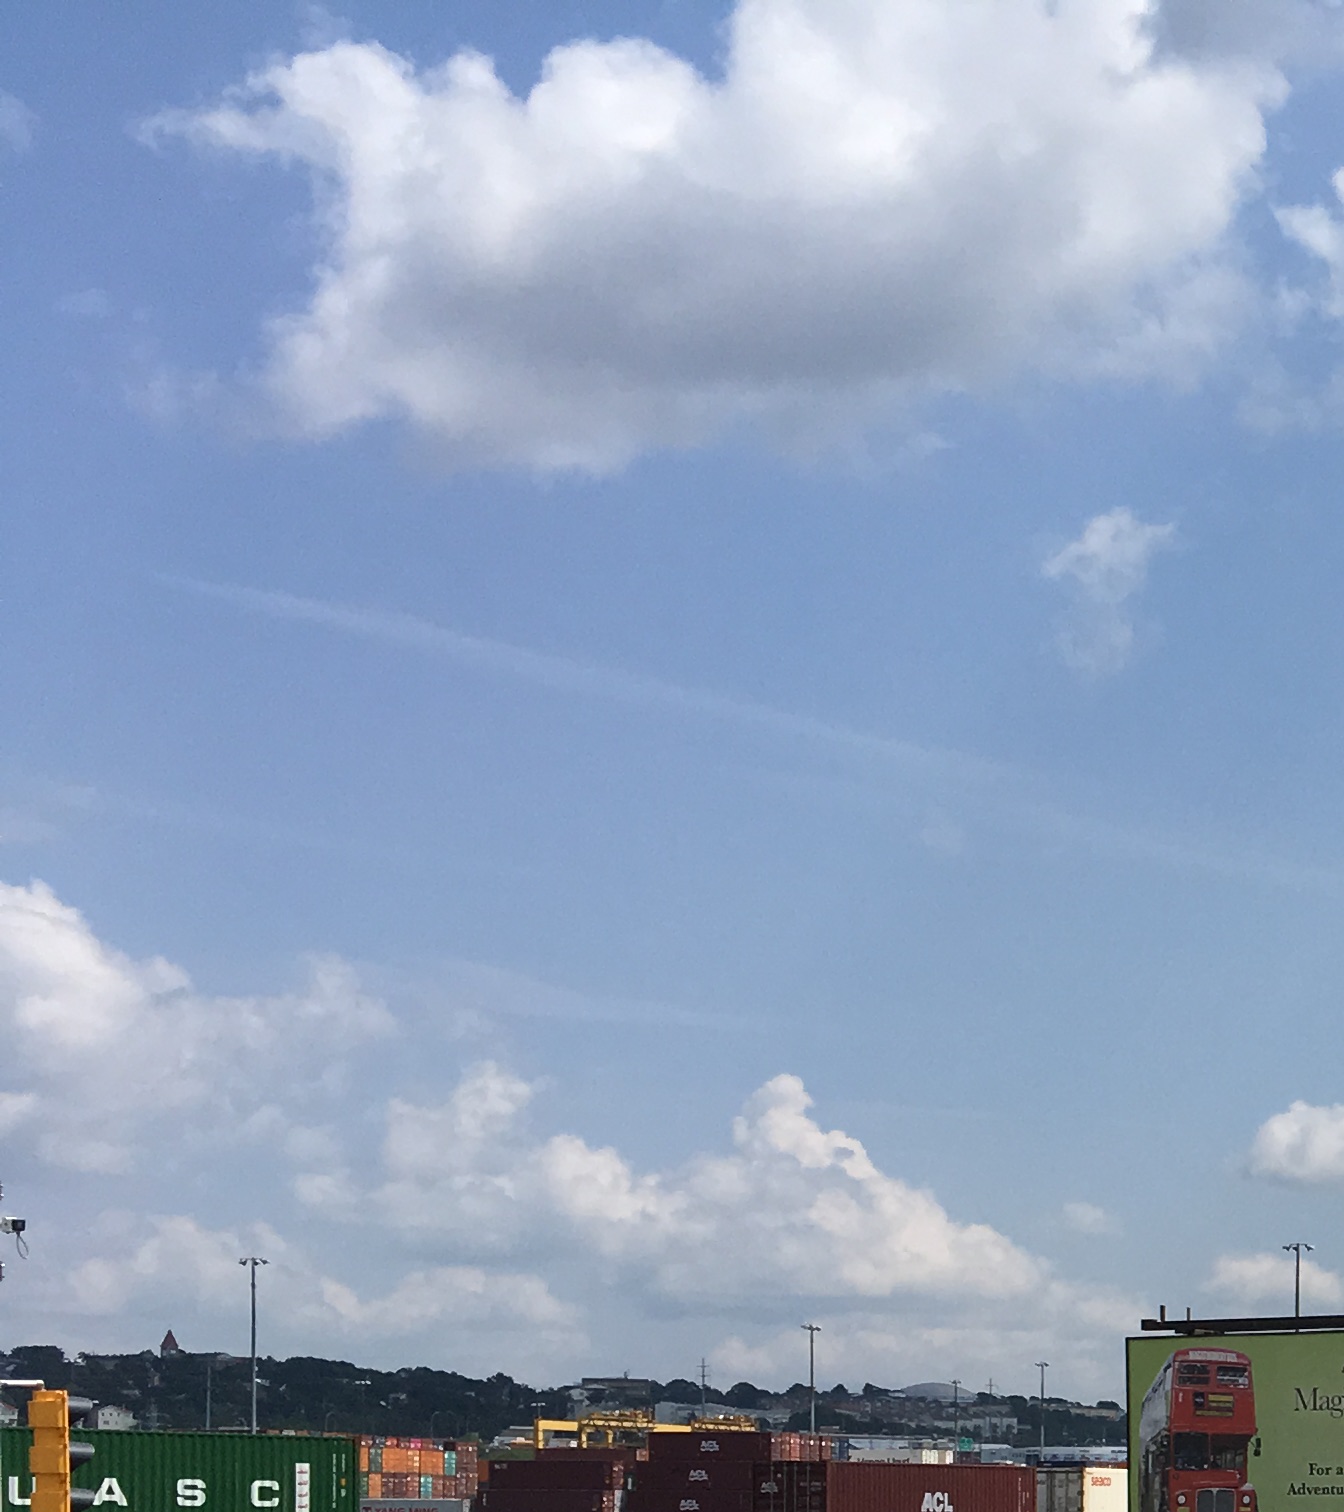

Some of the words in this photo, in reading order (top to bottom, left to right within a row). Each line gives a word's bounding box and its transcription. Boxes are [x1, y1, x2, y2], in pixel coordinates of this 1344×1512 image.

[1308, 1462, 1332, 1476] For
[1336, 1467, 1344, 1476] a
[921, 1491, 954, 1512] ACL
